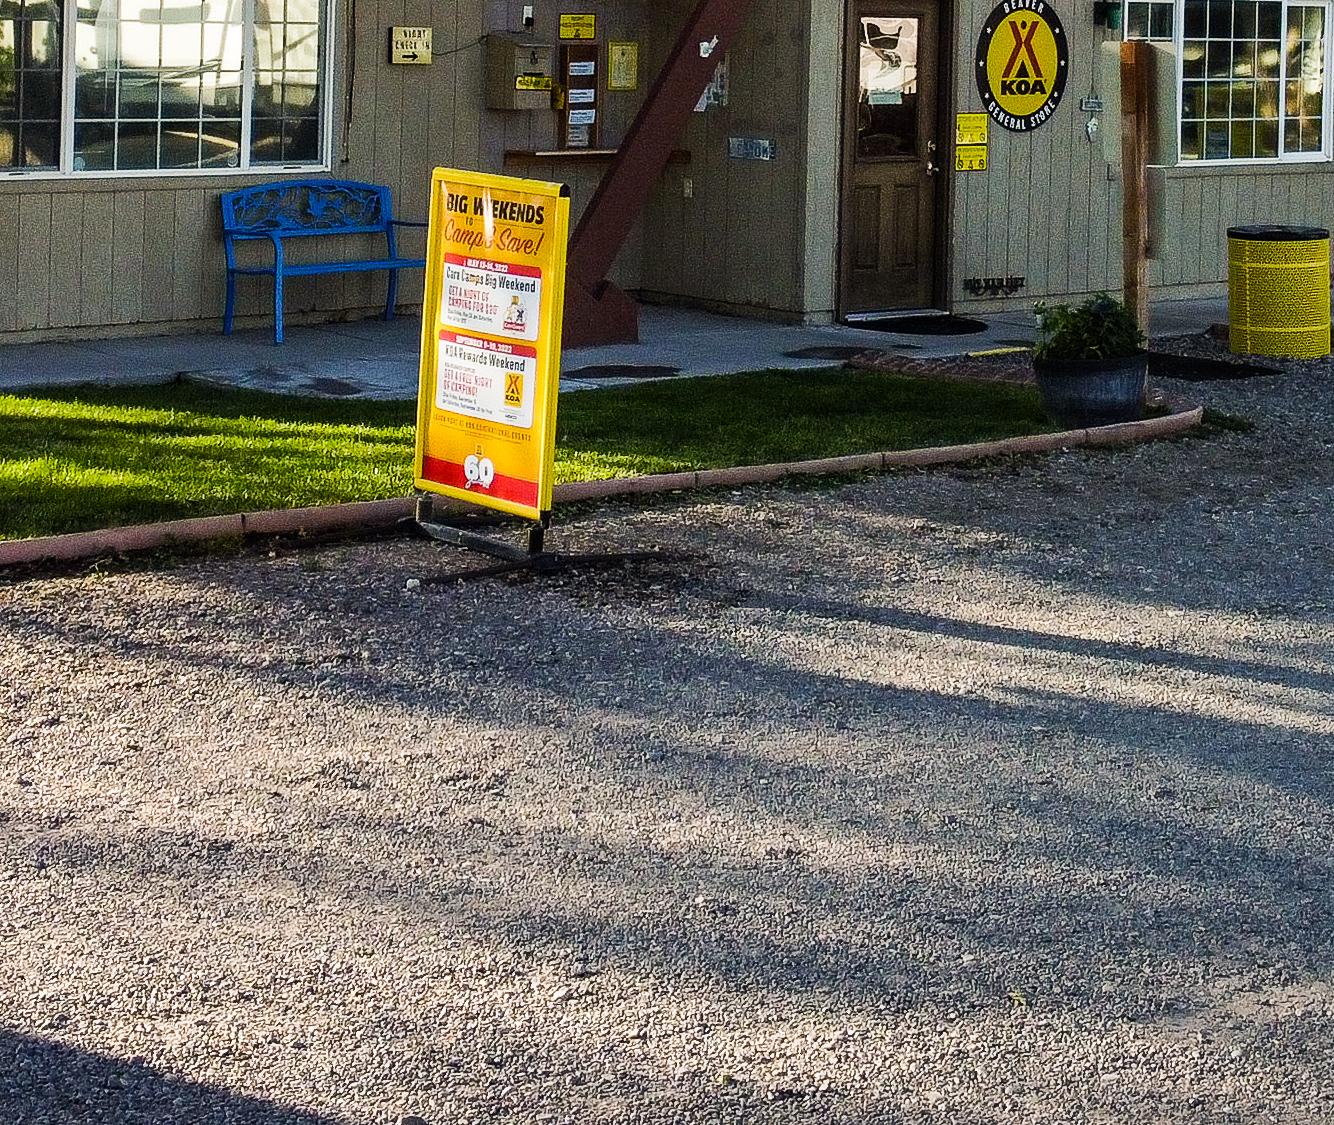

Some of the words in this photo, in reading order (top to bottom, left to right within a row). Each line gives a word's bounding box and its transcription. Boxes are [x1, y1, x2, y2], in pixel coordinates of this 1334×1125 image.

[1001, 80, 1047, 96] KOA
[988, 101, 1026, 130] GENERAL
[1030, 99, 1056, 127] STORE
[447, 193, 468, 214] BIG
[473, 197, 544, 225] WEKENDS
[444, 219, 483, 251] Camp
[496, 228, 545, 256] Save!
[461, 269, 484, 286] Camps
[485, 274, 497, 289] Big
[498, 275, 536, 293] Weekend
[458, 347, 487, 365] Rewards
[489, 353, 526, 372] Weekend
[505, 395, 521, 403] KOA
[464, 455, 495, 481] 60
